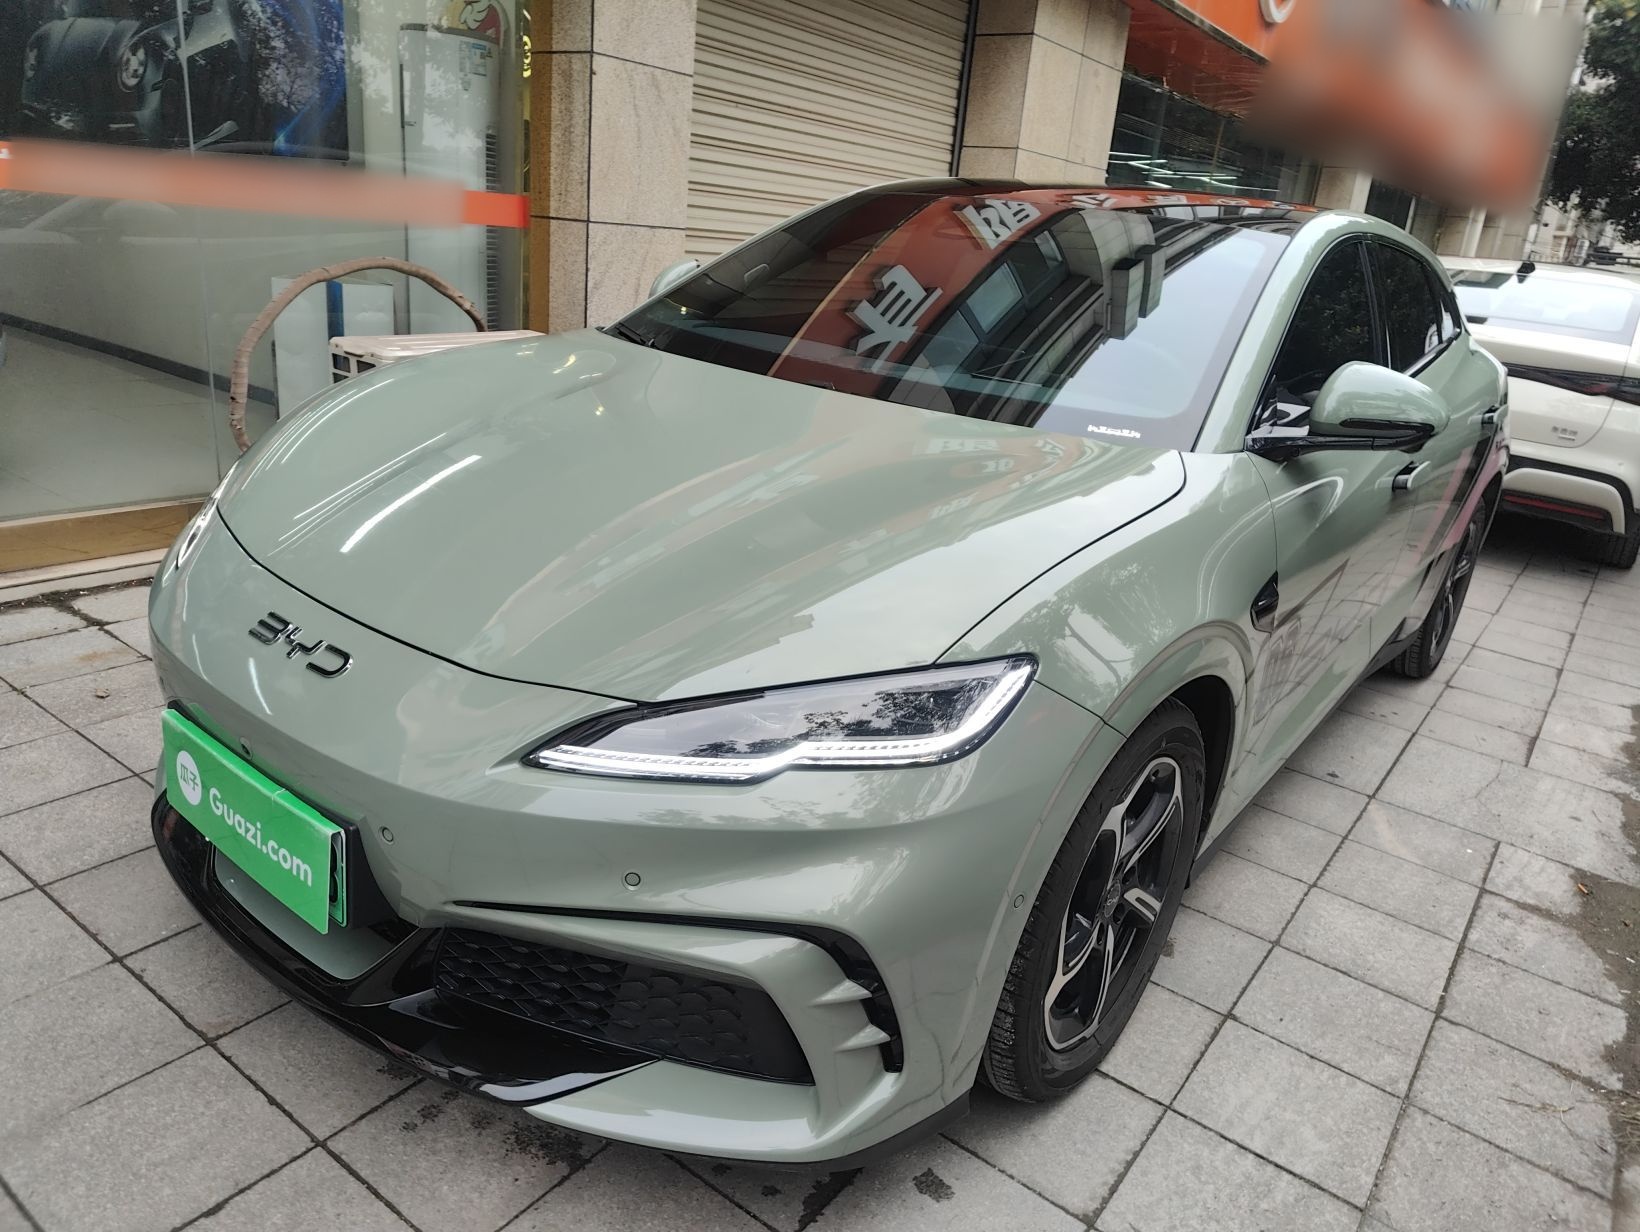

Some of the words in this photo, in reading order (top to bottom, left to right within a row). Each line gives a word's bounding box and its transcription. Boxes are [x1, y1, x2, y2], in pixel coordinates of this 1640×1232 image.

[248, 611, 353, 678] BYD
[180, 763, 199, 792] 瓜子
[209, 787, 312, 888] Guazi.com
